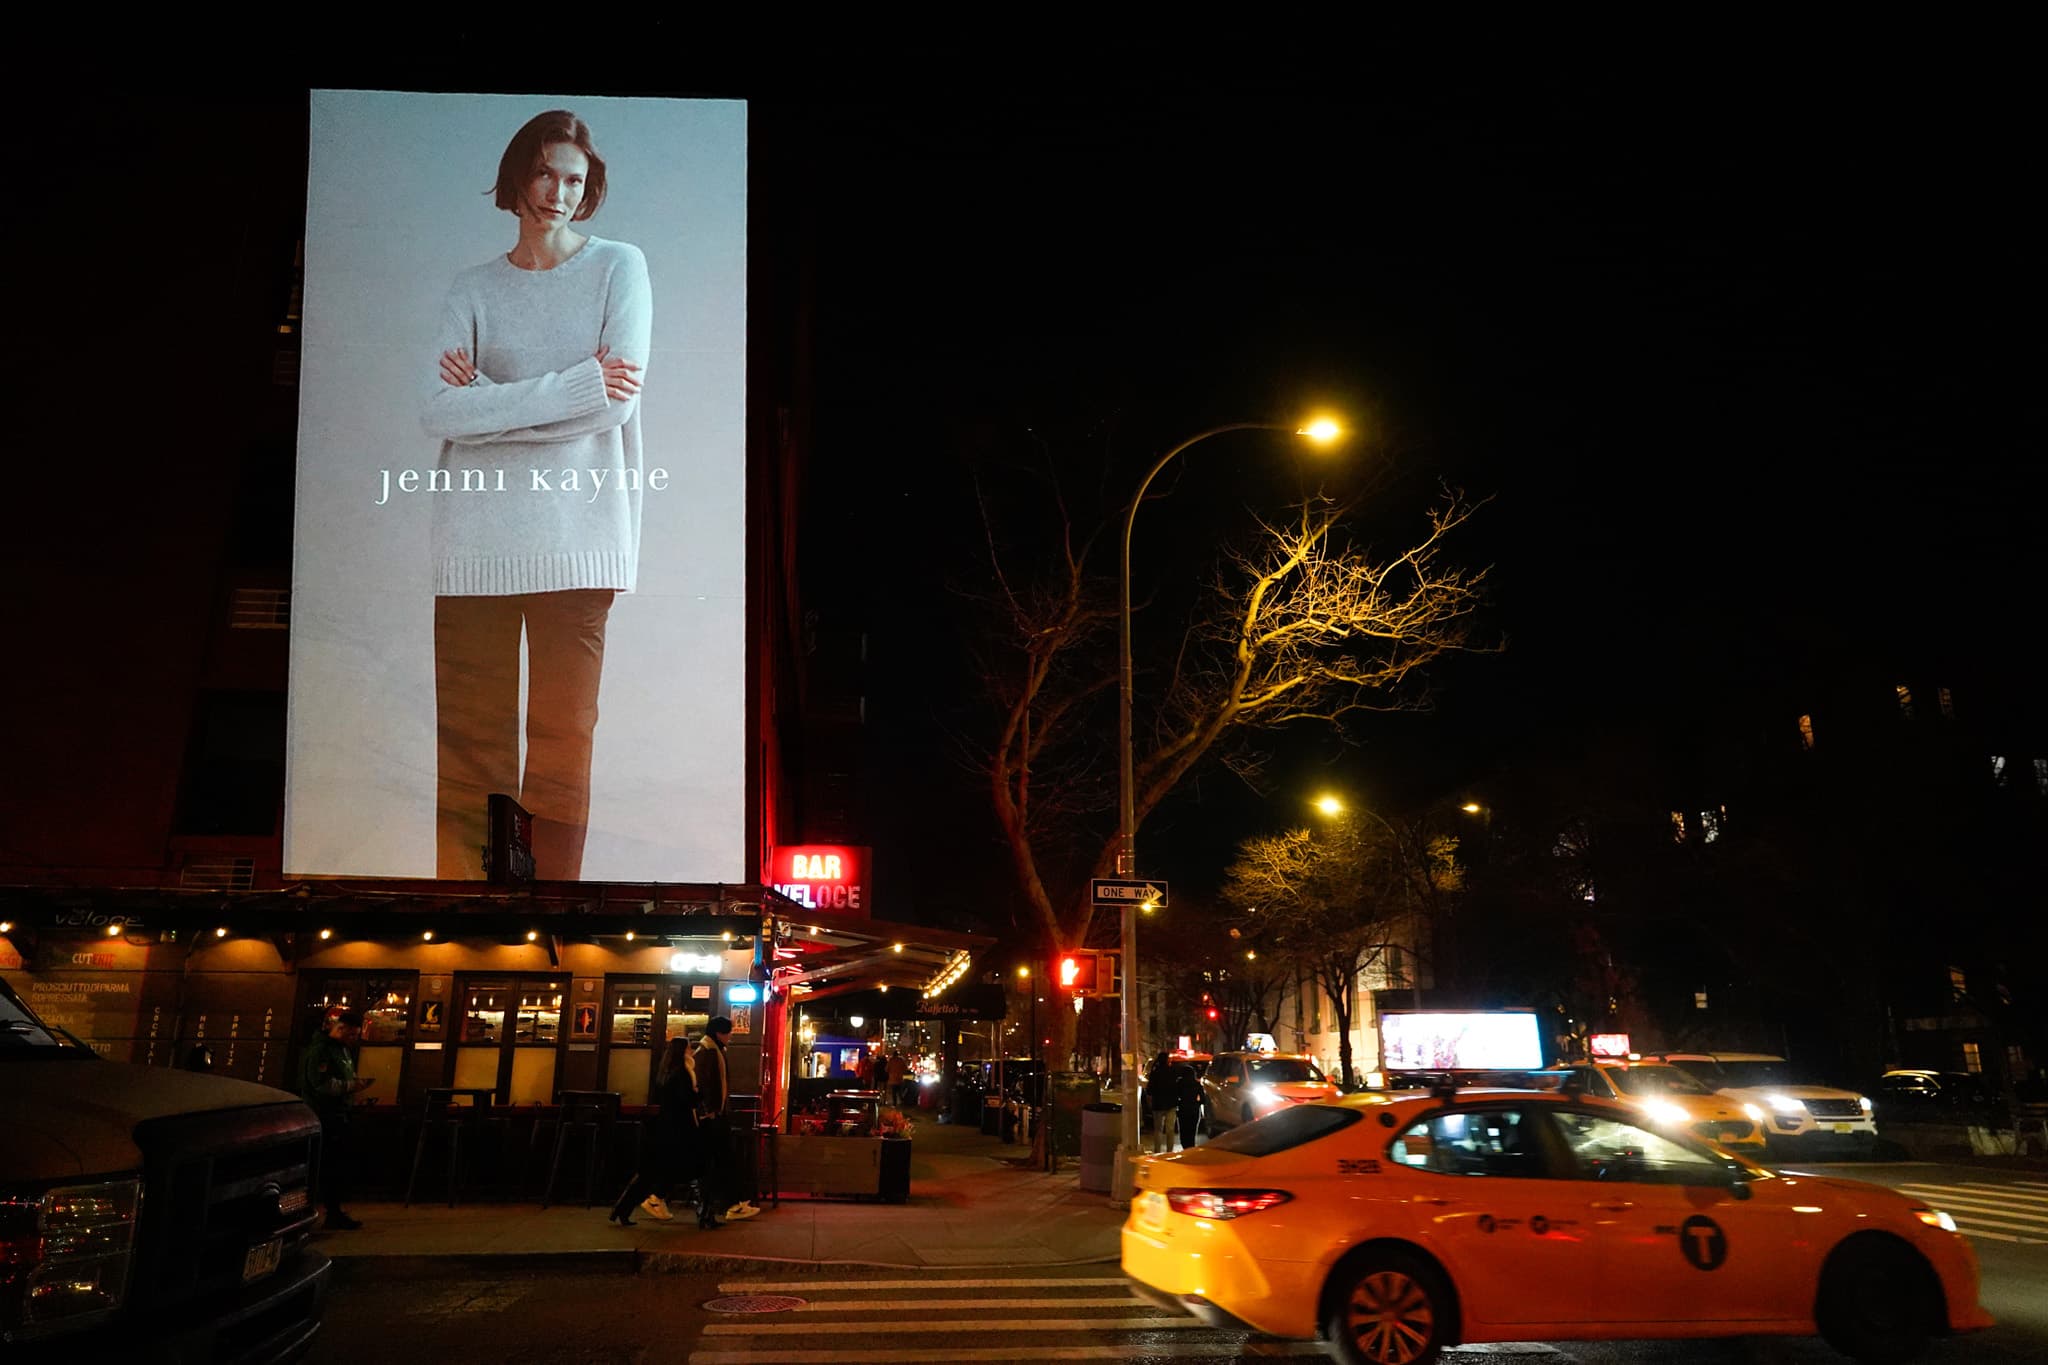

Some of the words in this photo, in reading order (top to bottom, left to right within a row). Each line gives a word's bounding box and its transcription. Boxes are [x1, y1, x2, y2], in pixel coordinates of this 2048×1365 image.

[792, 854, 842, 879] BAR
[773, 884, 861, 909] VELOCE
[1103, 888, 1125, 898] ONE
[1134, 888, 1156, 899] WAY
